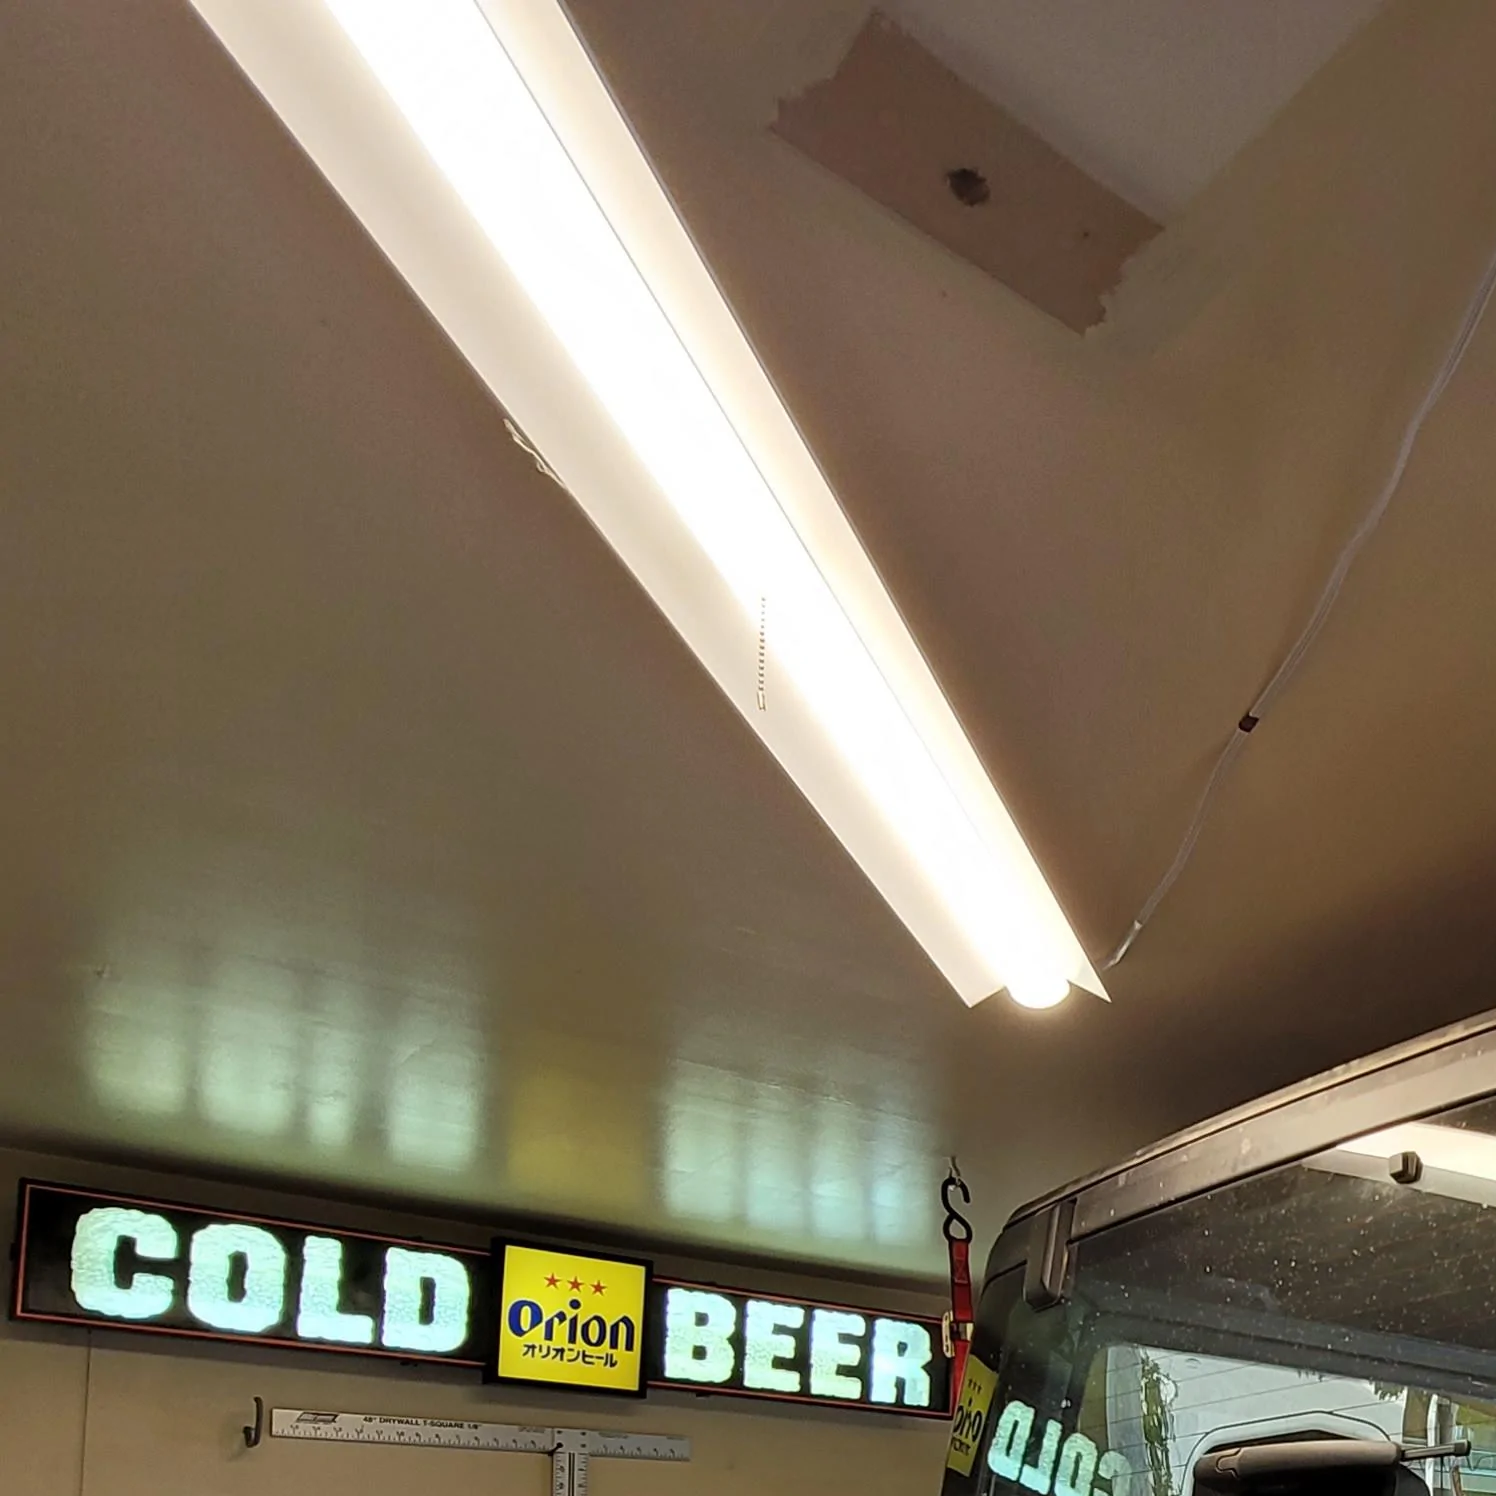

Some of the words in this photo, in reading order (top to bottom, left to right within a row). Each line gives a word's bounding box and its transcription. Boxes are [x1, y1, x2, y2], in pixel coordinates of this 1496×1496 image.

[71, 1207, 471, 1352] COLD
[508, 1299, 635, 1352] Orion
[664, 1288, 932, 1407] BEER
[380, 1417, 420, 1426] DRYWALL
[424, 1420, 464, 1429] T-SQUARE
